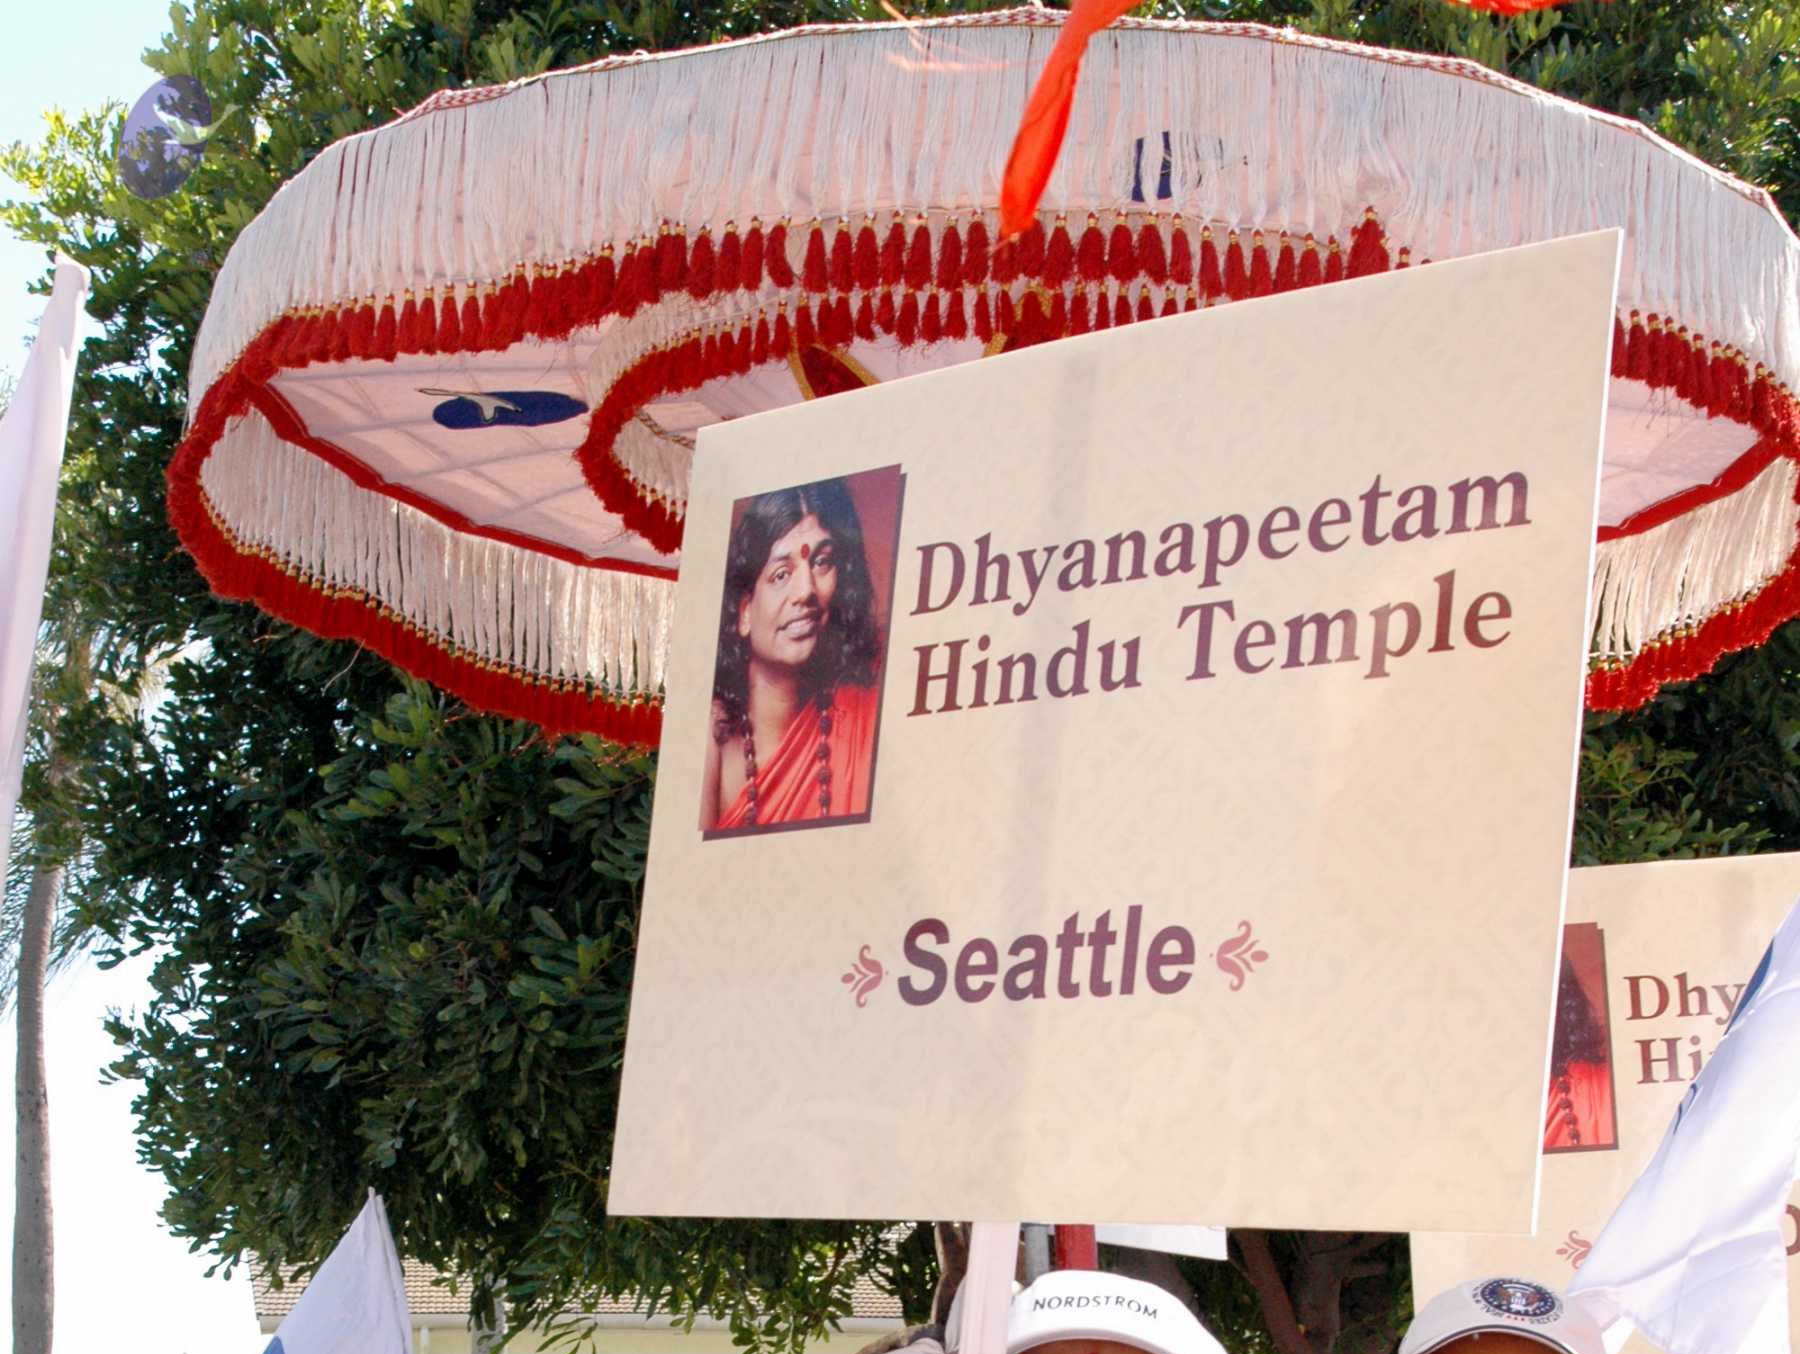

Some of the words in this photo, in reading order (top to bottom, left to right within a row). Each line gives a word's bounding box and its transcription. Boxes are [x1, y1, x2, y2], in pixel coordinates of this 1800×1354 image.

[909, 471, 1532, 617] Dhyanapeetam
[906, 619, 1142, 718] Hindu
[1176, 568, 1512, 682] Temple
[897, 904, 1196, 1007] Seattle
[1623, 971, 1746, 1026] Dhy
[1033, 1294, 1158, 1320] NORDSTROM
